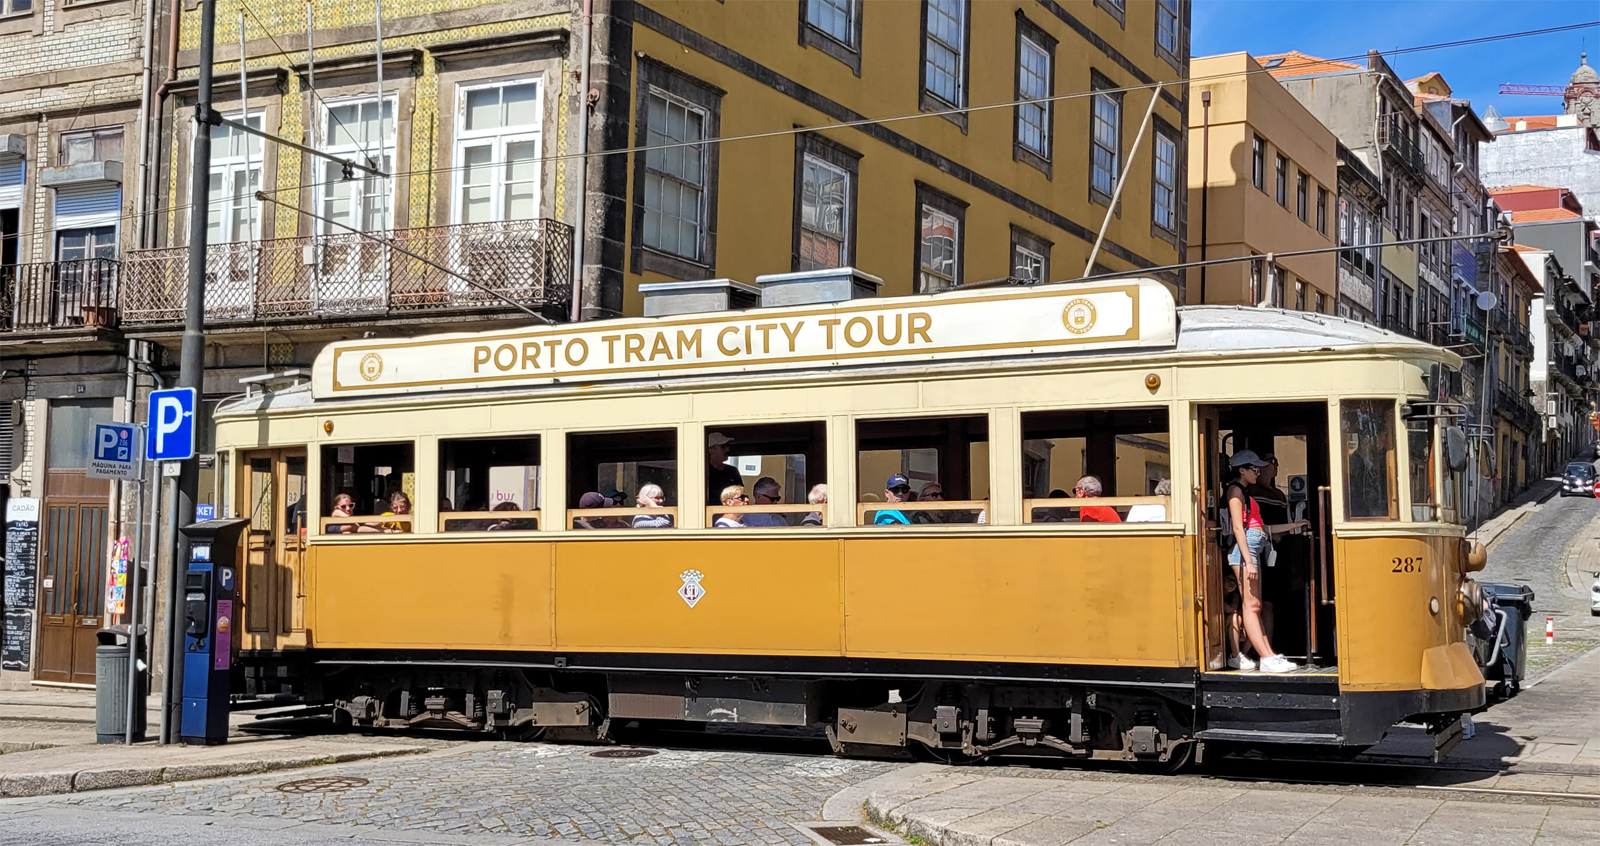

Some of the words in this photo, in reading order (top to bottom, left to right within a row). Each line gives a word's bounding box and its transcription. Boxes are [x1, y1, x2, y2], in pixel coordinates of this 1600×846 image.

[473, 337, 589, 373] PORTO
[601, 328, 703, 364] TRAM
[717, 321, 805, 357] CITY
[818, 312, 933, 350] TOUR
[156, 397, 183, 454] P
[98, 428, 118, 458] P
[222, 568, 232, 586] P
[1391, 556, 1423, 573] 287
